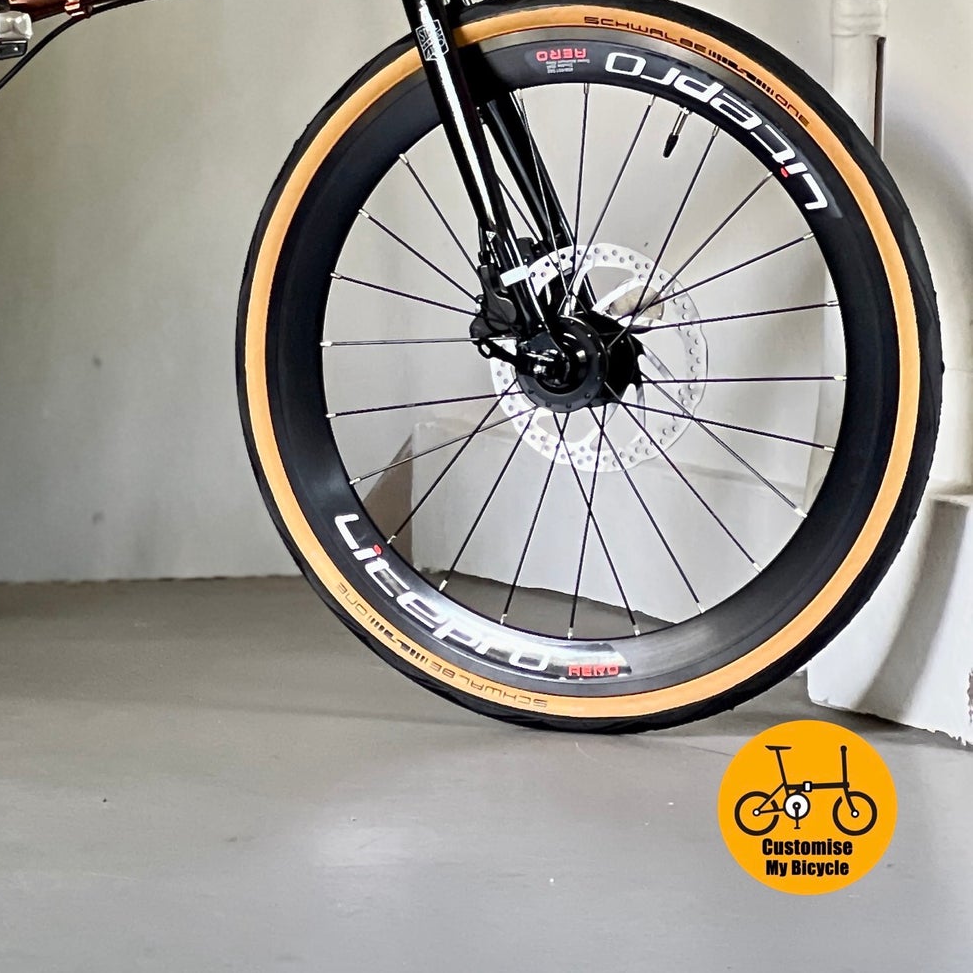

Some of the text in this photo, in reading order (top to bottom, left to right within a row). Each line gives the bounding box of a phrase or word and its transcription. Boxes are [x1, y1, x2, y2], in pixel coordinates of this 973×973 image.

[536, 47, 587, 62] AERO
[584, 16, 810, 127] SCHWALBE ONE
[337, 583, 548, 708] SCHWALBE ONE
